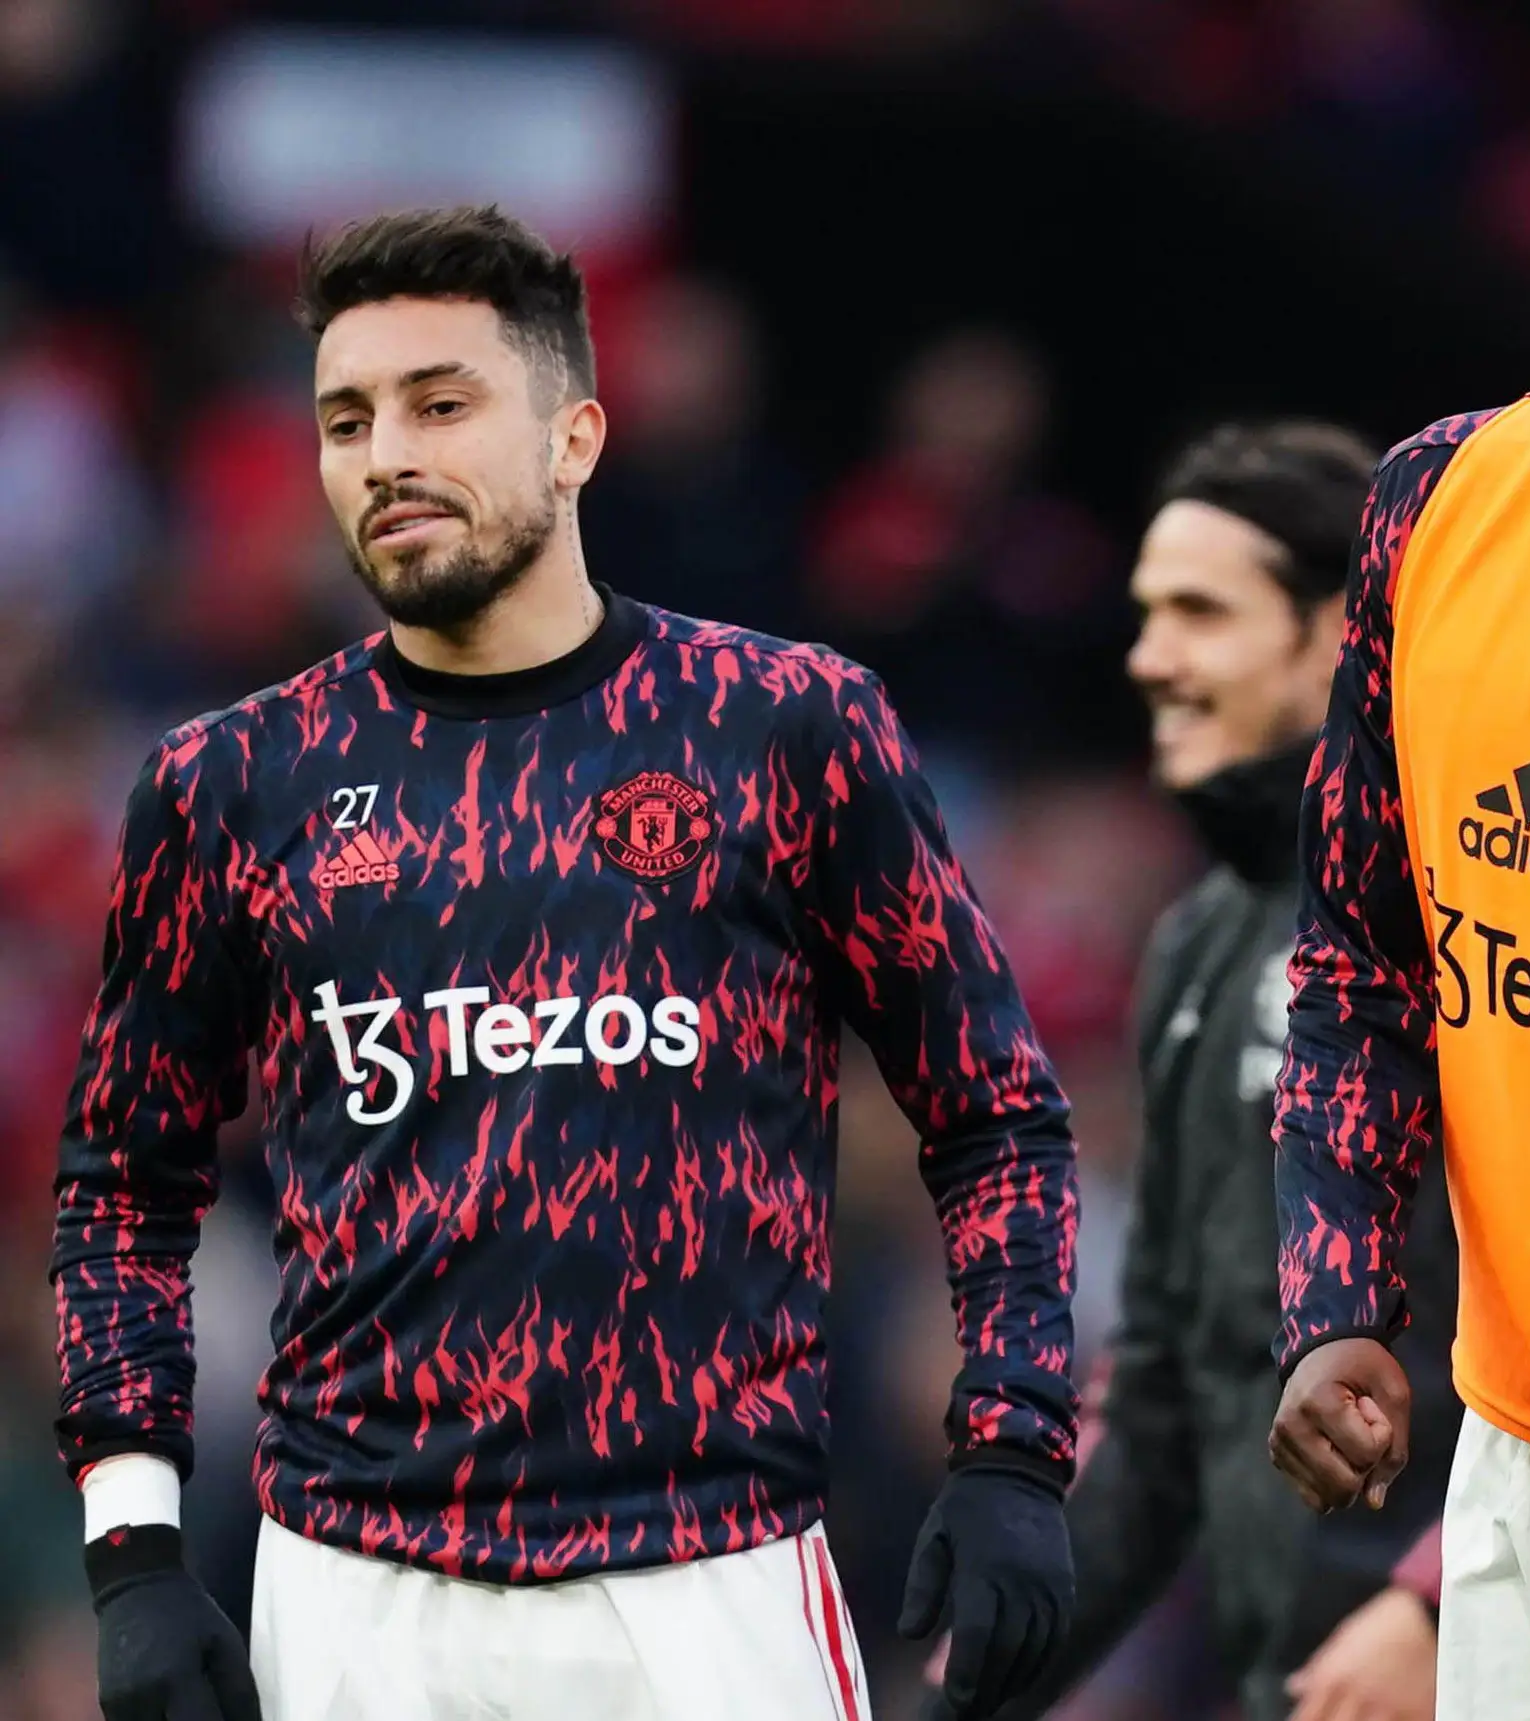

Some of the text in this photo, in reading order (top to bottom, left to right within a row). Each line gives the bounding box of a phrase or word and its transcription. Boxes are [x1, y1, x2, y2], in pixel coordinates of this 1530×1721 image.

[332, 784, 380, 829] 27
[608, 778, 700, 814] MANCHESTER
[319, 863, 400, 889] adidas
[621, 849, 686, 871] UNITED
[423, 986, 700, 1077] Tezos
